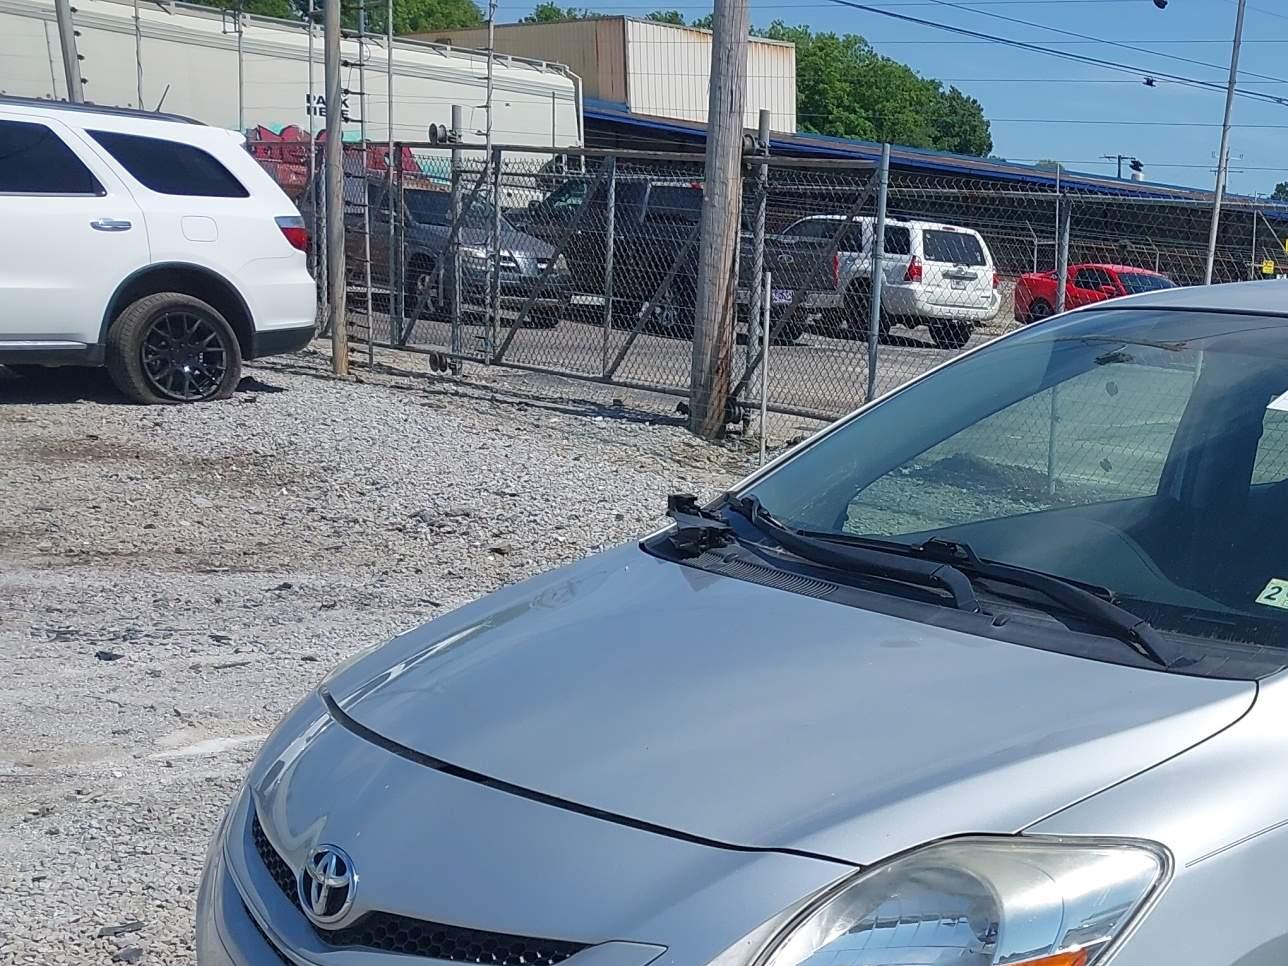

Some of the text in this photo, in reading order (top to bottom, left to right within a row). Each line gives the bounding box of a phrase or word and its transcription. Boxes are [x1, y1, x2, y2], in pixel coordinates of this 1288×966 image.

[306, 94, 349, 108] PAK
[306, 105, 349, 118] HEE
[1264, 586, 1282, 600] 2
